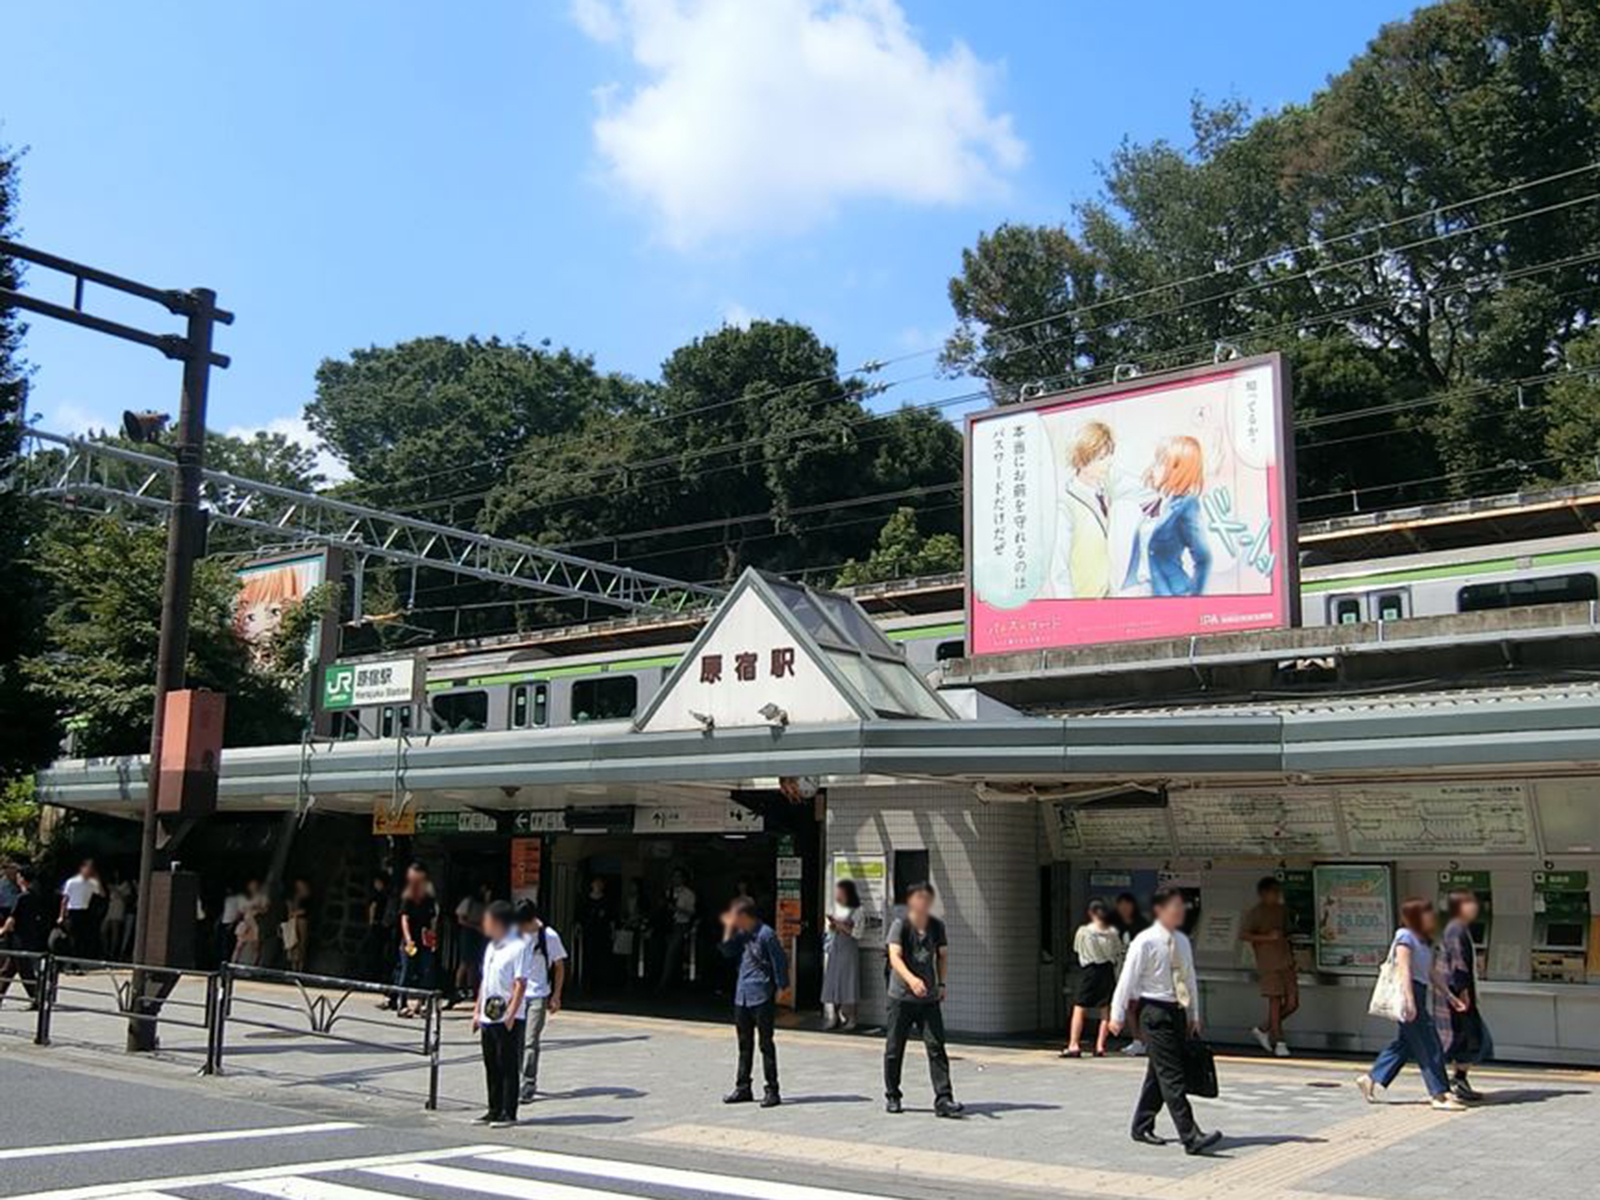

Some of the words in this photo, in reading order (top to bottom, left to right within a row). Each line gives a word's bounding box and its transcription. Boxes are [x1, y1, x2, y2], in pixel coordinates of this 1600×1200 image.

[993, 428, 1006, 556] パスワードだけだぜ
[700, 647, 795, 684] 原宿駅
[327, 672, 352, 693] JR
[356, 668, 392, 687] 原宿駅
[1163, 860, 1171, 870] 2
[1204, 860, 1213, 870] 3
[1278, 860, 1287, 869] 4
[1450, 860, 1459, 870] 5
[1544, 860, 1554, 870] 6
